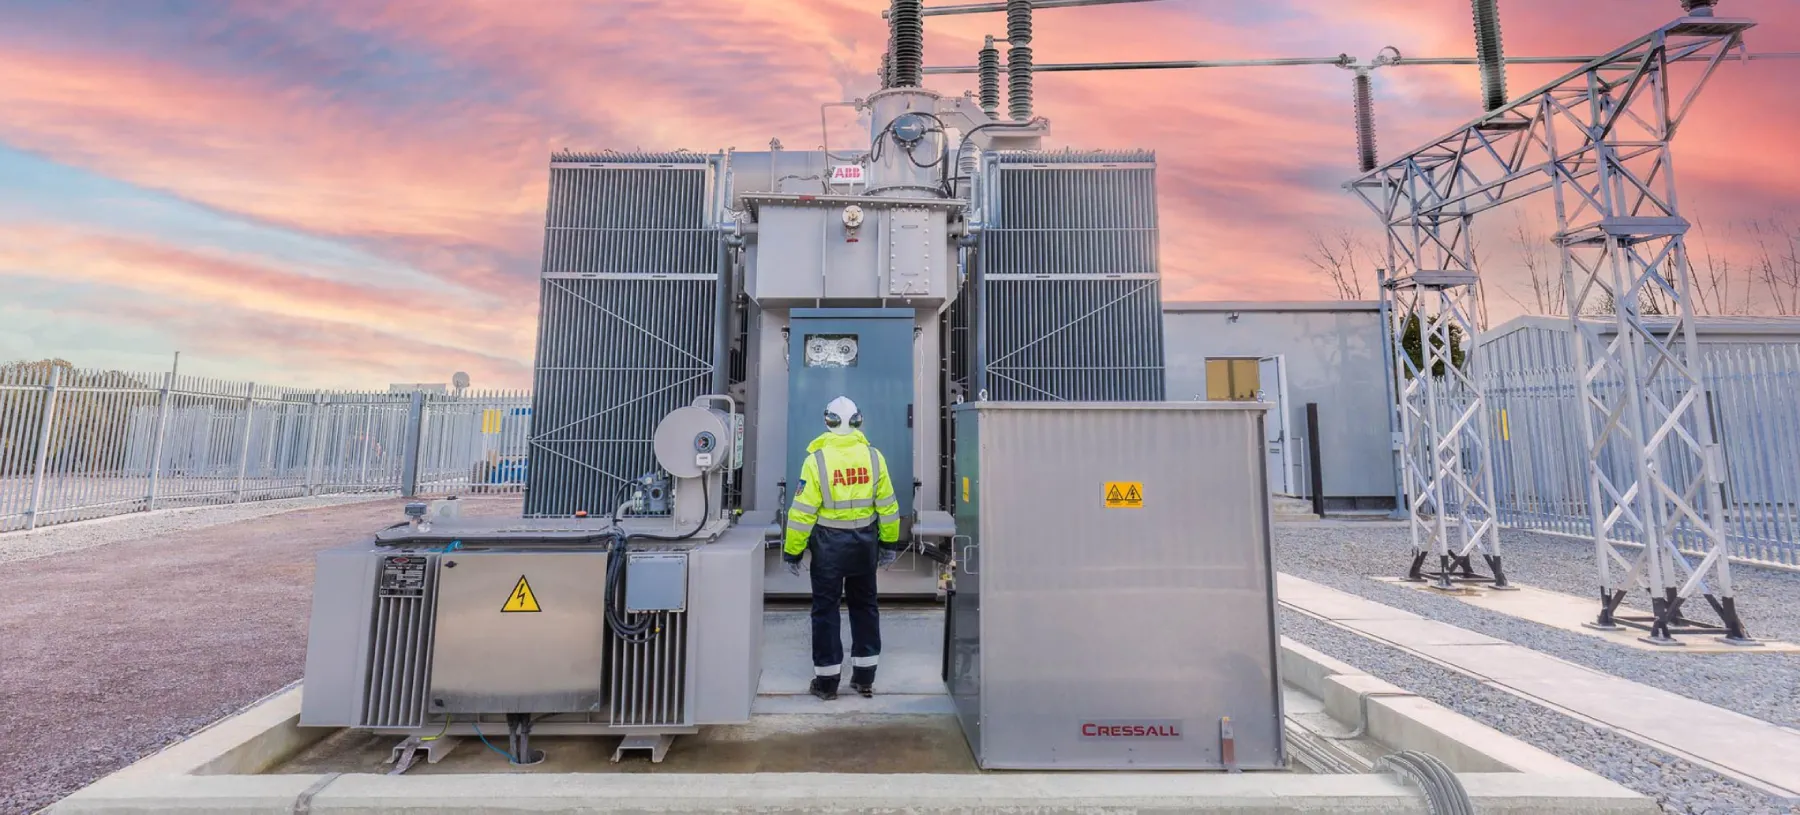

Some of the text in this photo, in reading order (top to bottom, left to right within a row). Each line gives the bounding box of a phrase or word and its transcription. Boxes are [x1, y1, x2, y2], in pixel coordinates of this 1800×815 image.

[834, 167, 861, 178] ABB
[833, 467, 870, 486] ABB
[1082, 723, 1180, 737] CRESSALL
